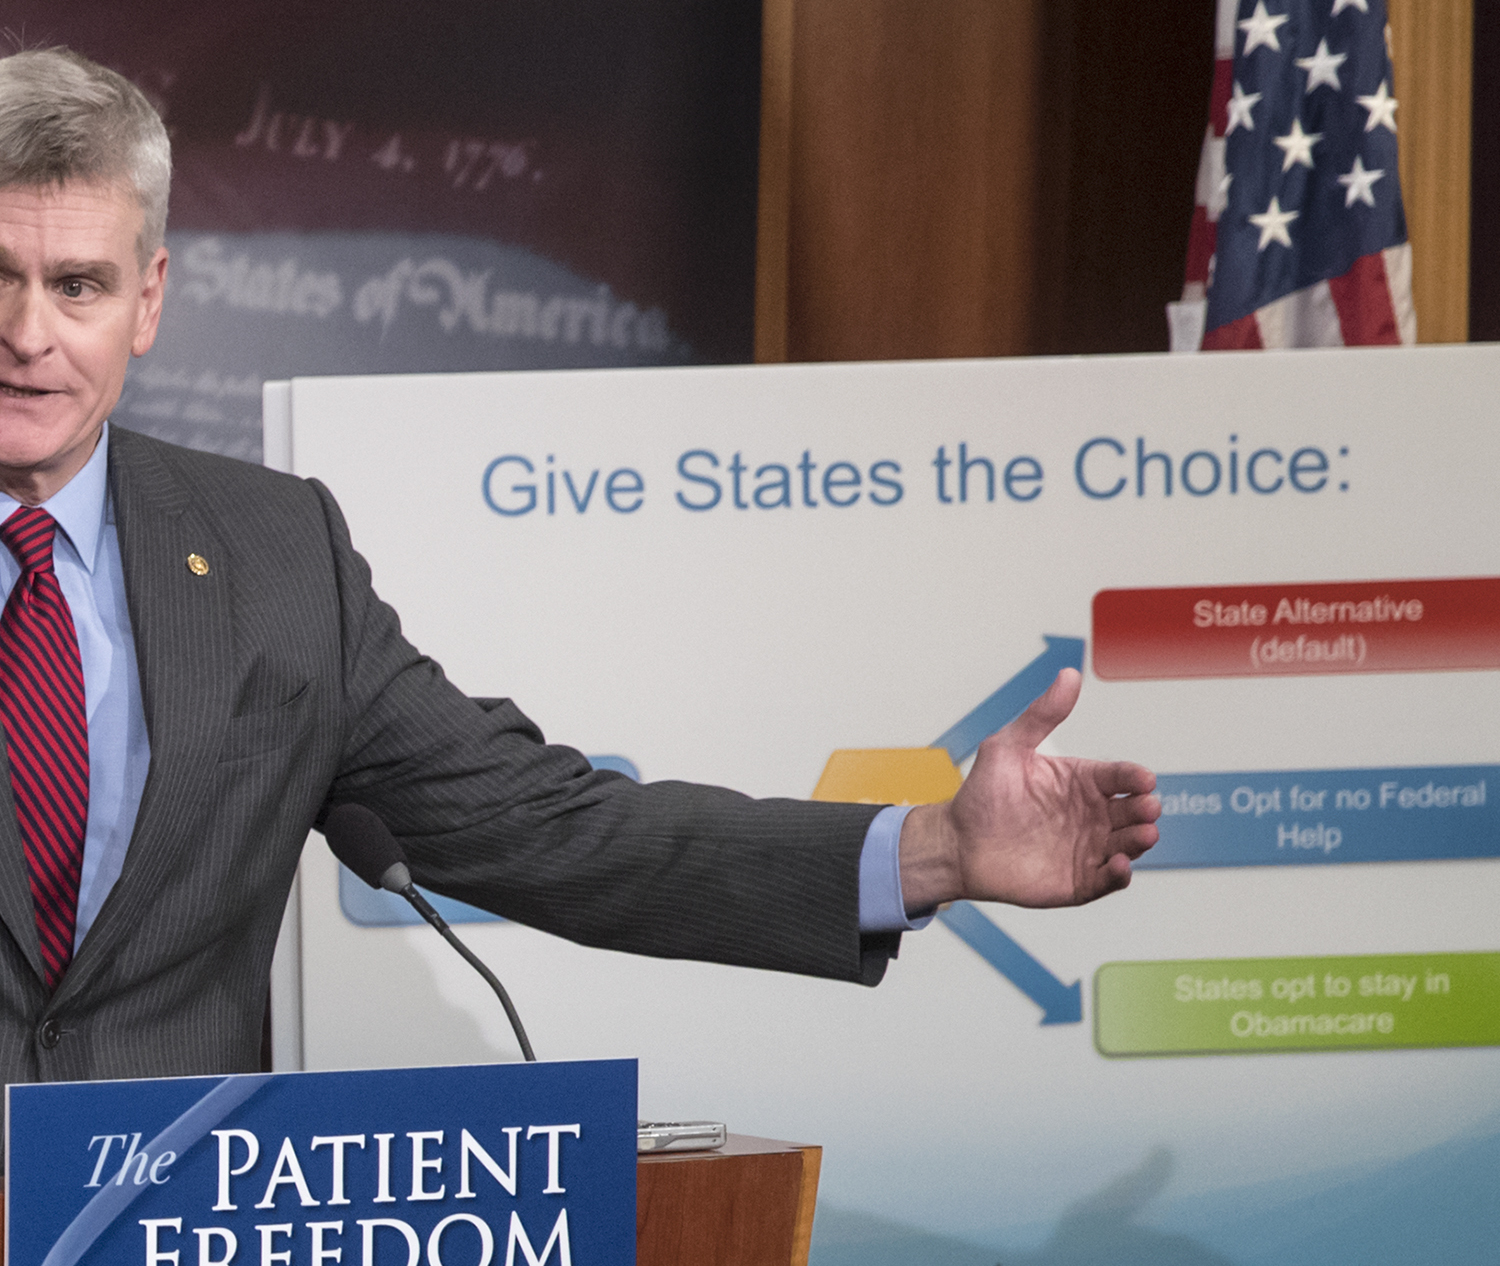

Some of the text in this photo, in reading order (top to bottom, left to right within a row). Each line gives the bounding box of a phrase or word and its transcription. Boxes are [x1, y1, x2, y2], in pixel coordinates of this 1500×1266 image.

[181, 236, 343, 319] States
[352, 256, 412, 344] of
[481, 436, 1351, 518] Give States the Choice:
[1193, 595, 1425, 628] State Alternative
[1250, 634, 1368, 669] (default)
[1230, 786, 1282, 818] Opt
[1289, 784, 1328, 812] for
[1335, 788, 1371, 811] no
[1378, 780, 1487, 810] Federal
[1277, 823, 1343, 854] Help
[1174, 967, 1451, 1004] States opt to stay in
[1230, 1009, 1395, 1038] Obamacare
[83, 1124, 581, 1211] The PATIENT
